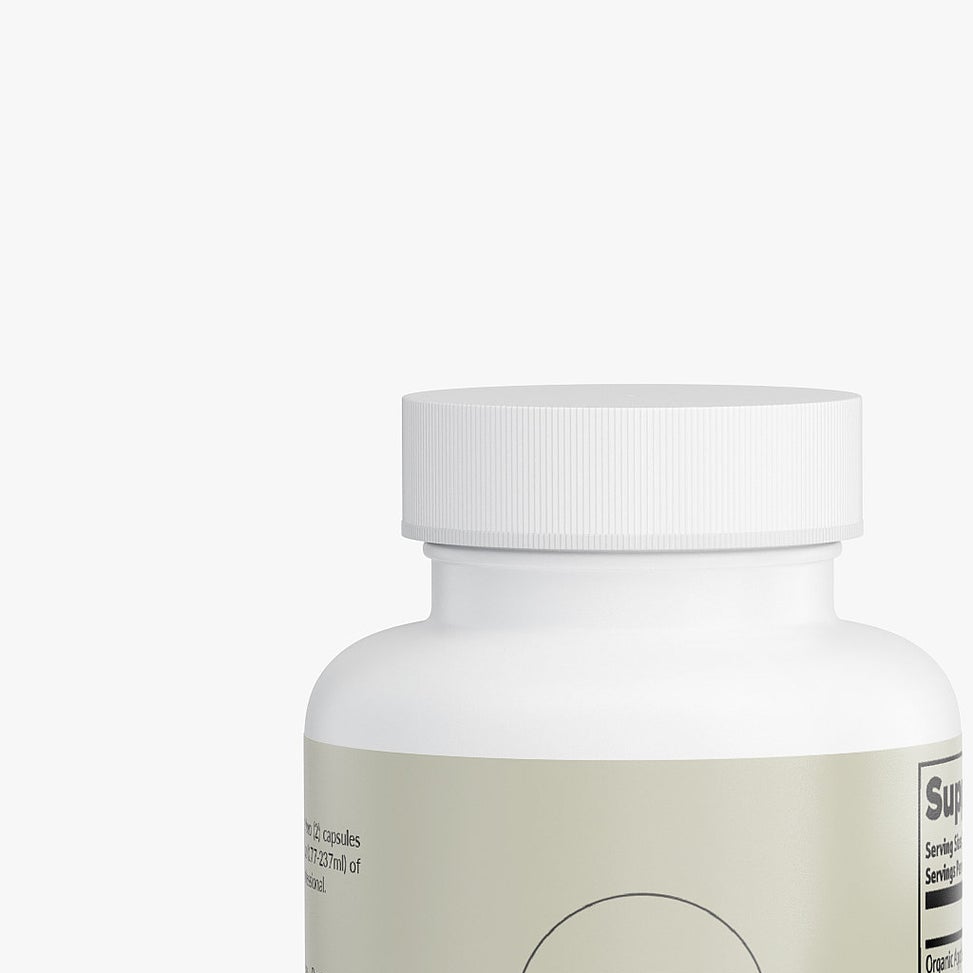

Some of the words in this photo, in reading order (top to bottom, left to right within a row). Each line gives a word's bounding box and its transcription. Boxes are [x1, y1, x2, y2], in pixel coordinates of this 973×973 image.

[323, 829, 361, 848] capsules
[925, 837, 953, 860] Serving
[349, 858, 361, 874] of
[925, 863, 956, 885] Servings
